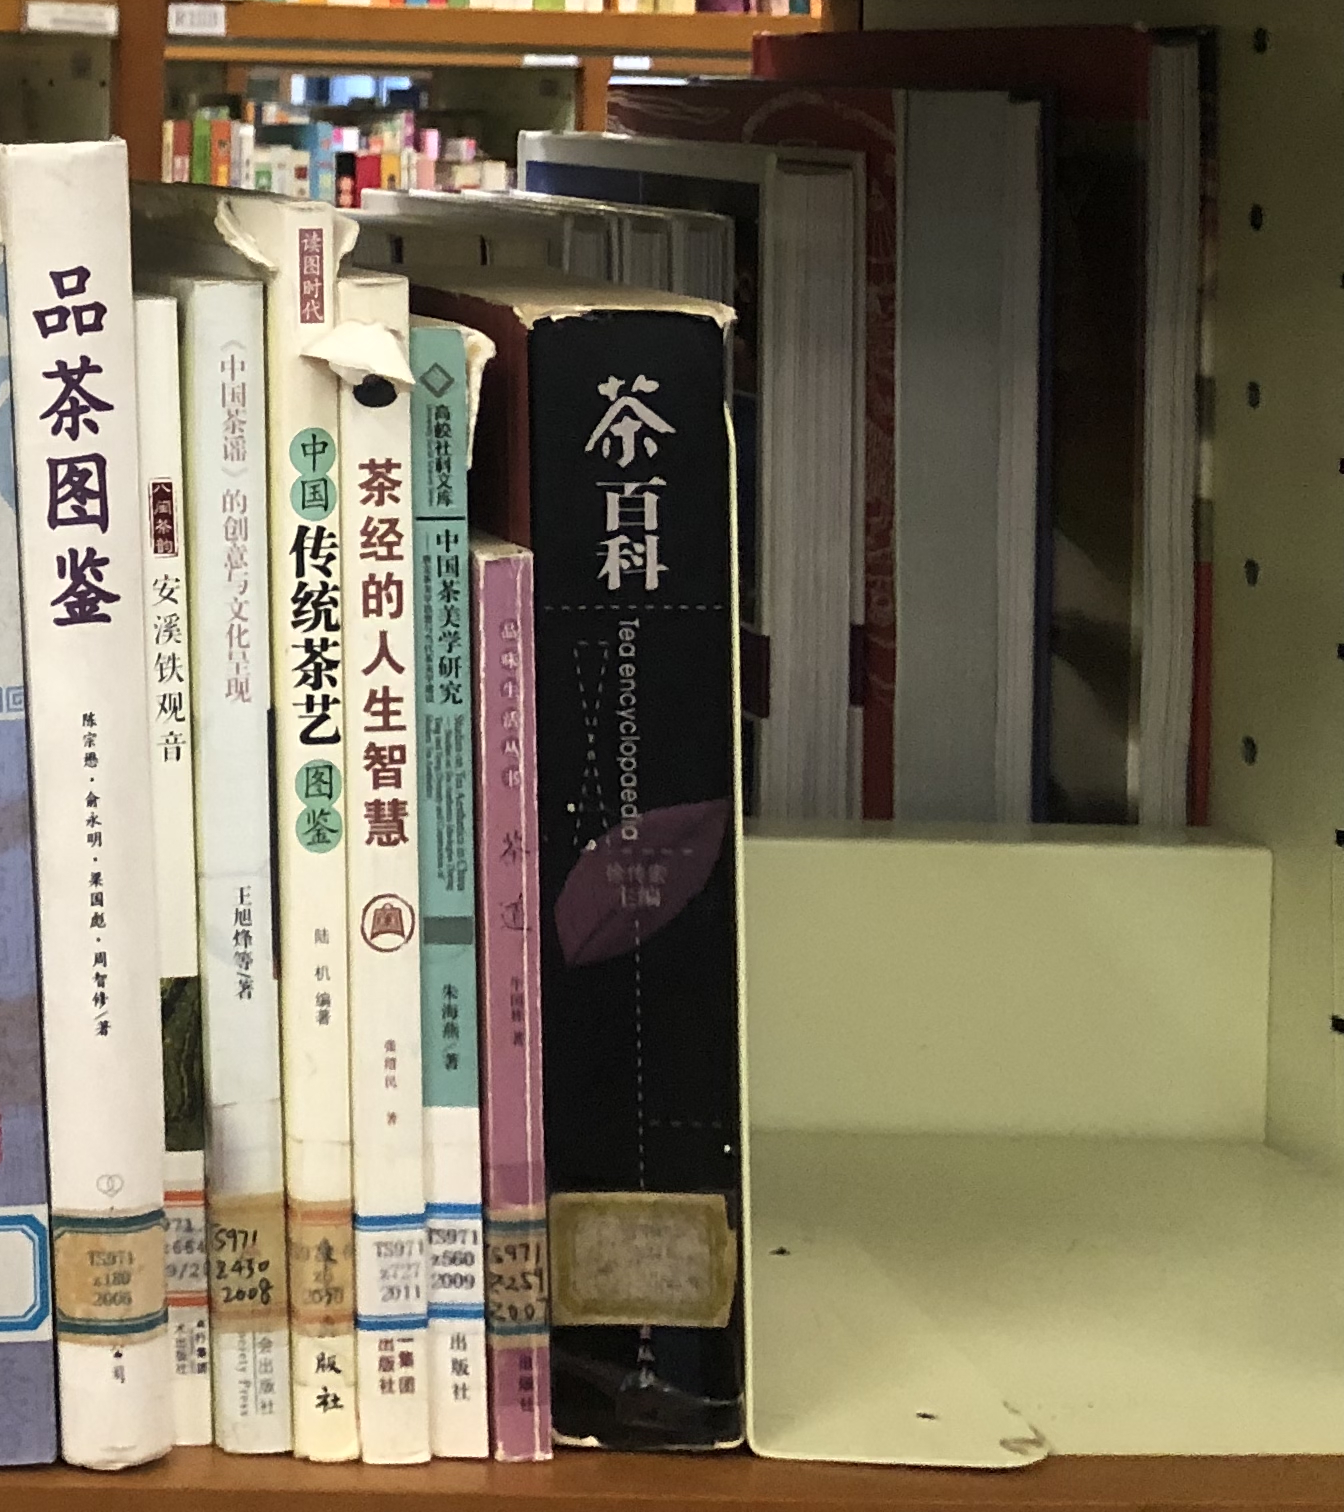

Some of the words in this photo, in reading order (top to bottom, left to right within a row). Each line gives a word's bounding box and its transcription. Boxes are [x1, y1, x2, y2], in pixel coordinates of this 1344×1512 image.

[300, 229, 324, 322] 读图时代
[31, 264, 122, 627] 品茶图鉴
[584, 374, 678, 592] 茶百科
[152, 575, 188, 764] 安溪铁观音
[289, 432, 343, 848] 中国传统茶艺图鉴
[358, 457, 410, 846] 茶经的人生智慧
[436, 528, 464, 706] 中国茶美学研究
[617, 618, 641, 656] Tea
